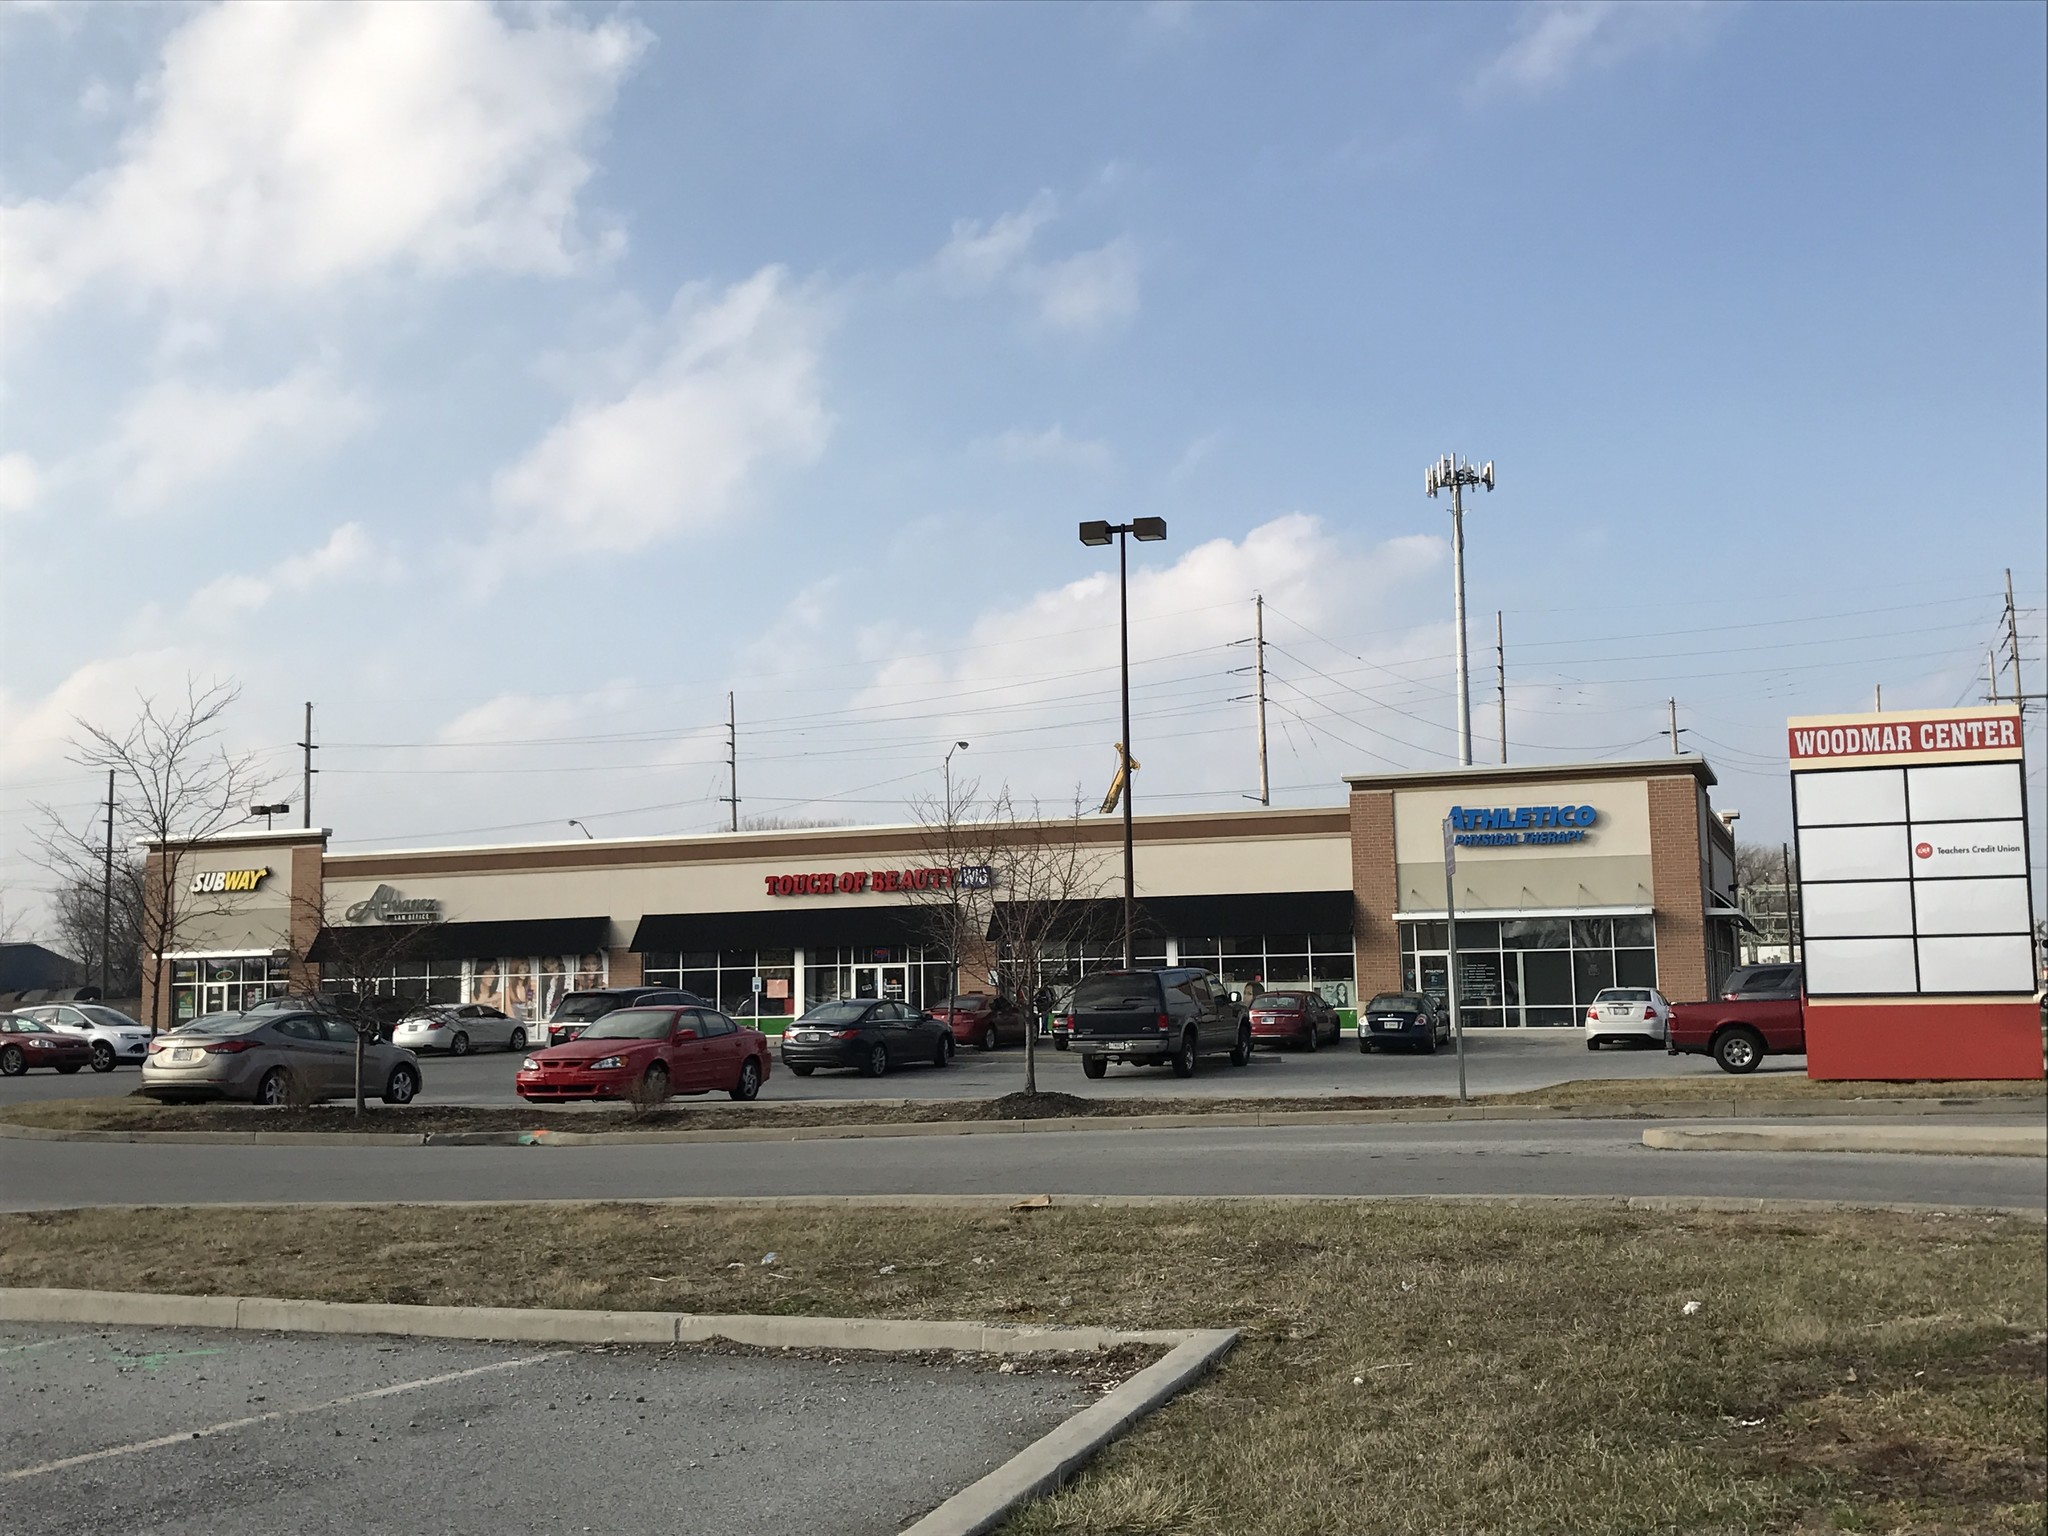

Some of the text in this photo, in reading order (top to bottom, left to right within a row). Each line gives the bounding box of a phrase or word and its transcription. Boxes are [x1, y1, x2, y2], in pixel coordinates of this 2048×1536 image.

[1794, 720, 2016, 756] WOODMAR CENTER
[1448, 805, 1598, 830] ATHLETICO
[1454, 830, 1585, 846] PHYSICAL THERAPY
[1937, 846, 1970, 855] Teachers
[1972, 845, 1995, 854] Credit
[1997, 845, 2021, 853] Union
[190, 868, 268, 893] SUBWAY
[765, 873, 836, 896] TOUCH
[838, 871, 868, 893] OF
[871, 867, 959, 892] BEAUTY
